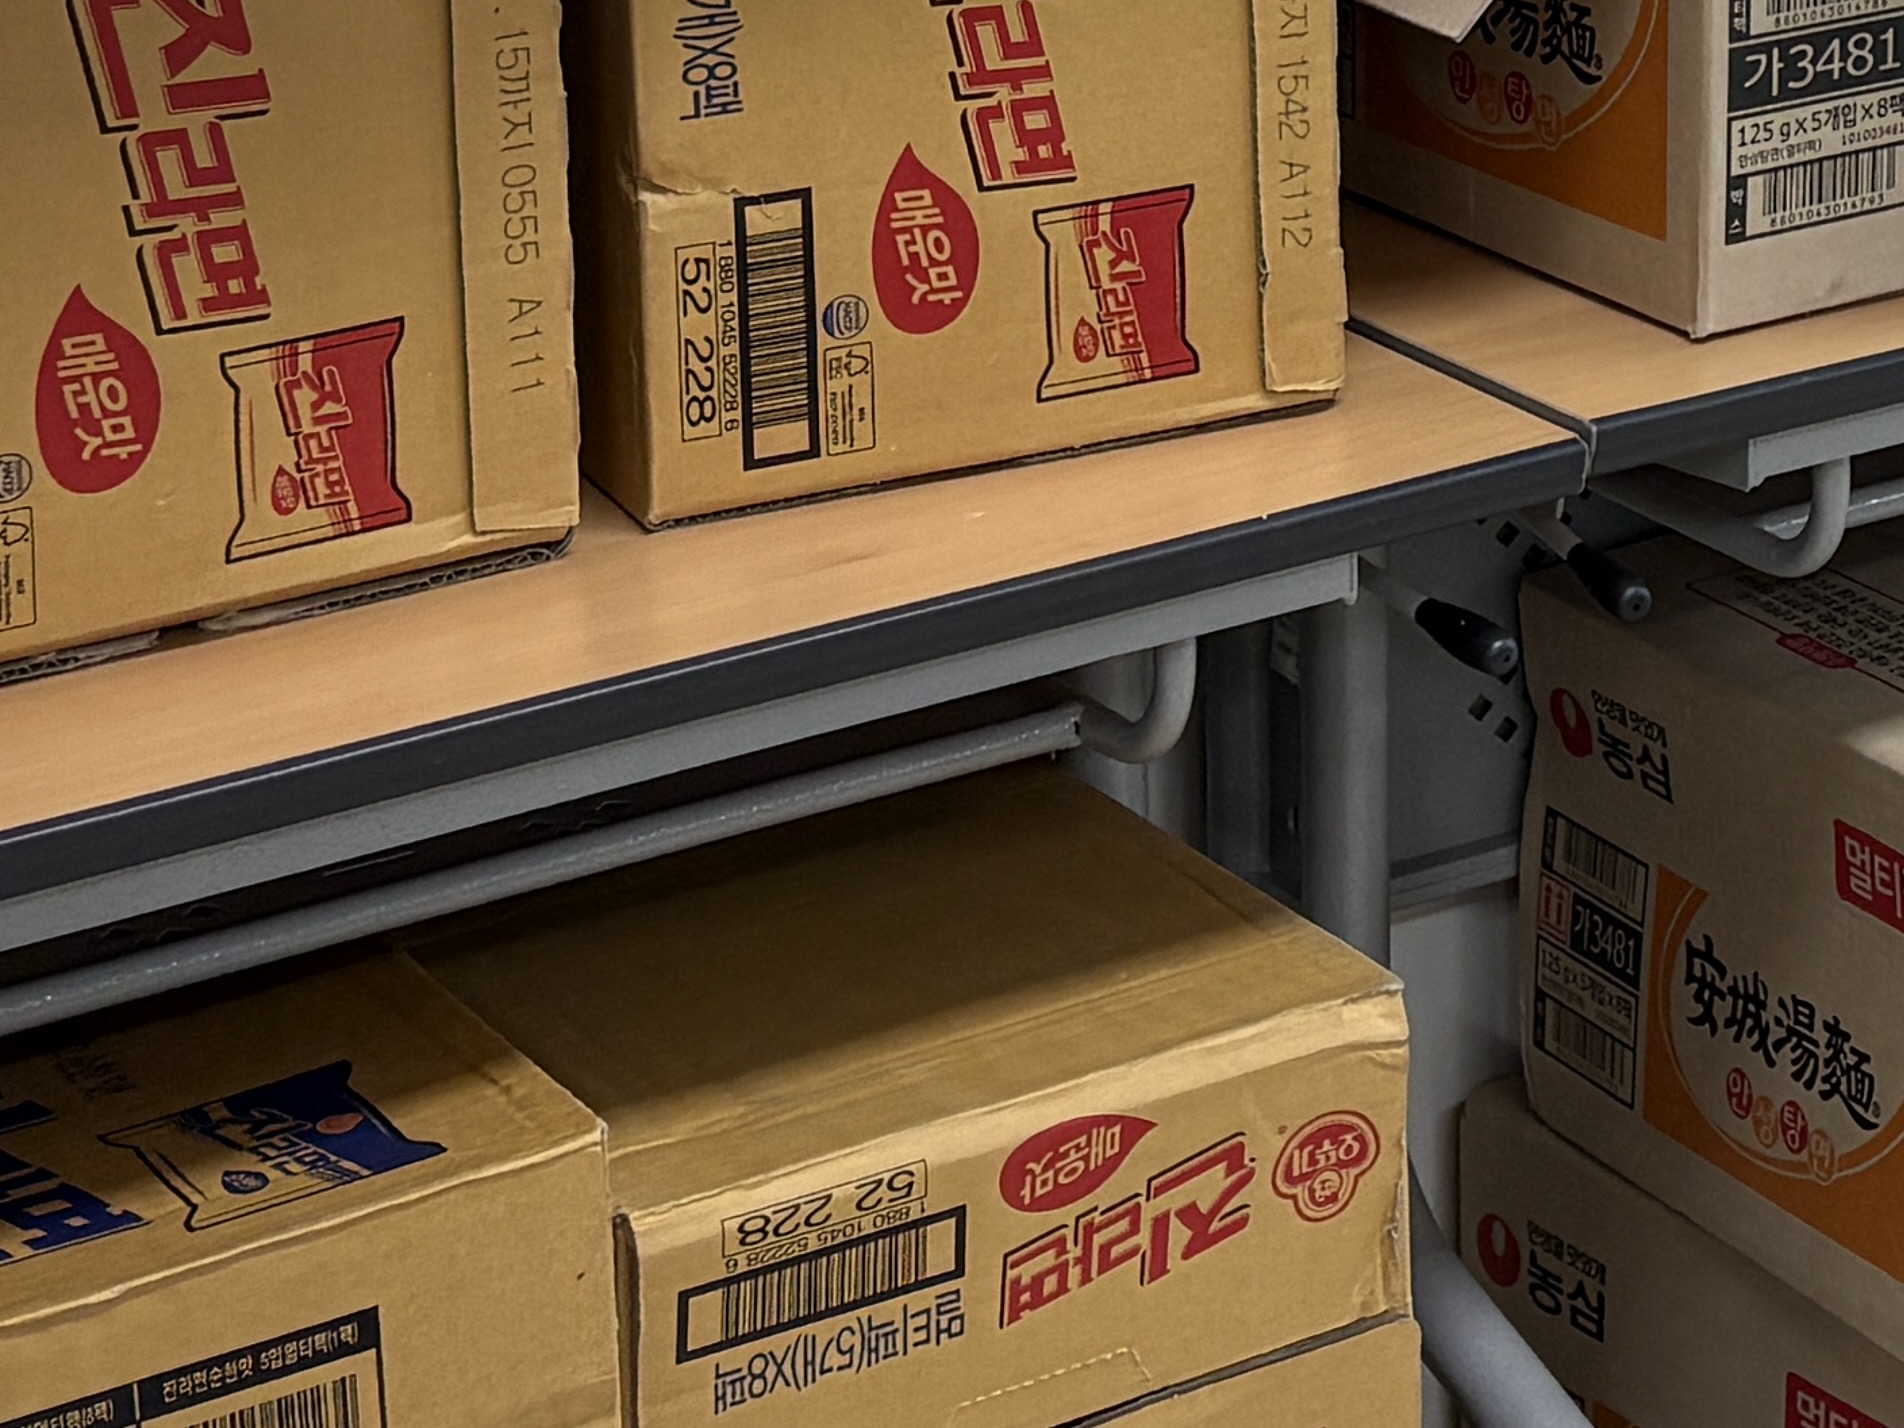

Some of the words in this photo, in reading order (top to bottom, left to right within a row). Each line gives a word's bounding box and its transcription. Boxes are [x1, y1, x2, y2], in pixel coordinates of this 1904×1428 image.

[1276, 49, 1310, 142] 1542
[1743, 26, 1902, 97] 가3481
[1277, 160, 1312, 249] A112
[679, 253, 711, 316] 52
[888, 191, 965, 310] 매운맛
[1085, 226, 1145, 358] 진라면
[507, 296, 547, 394] A111
[683, 338, 717, 428] 228
[55, 332, 143, 467] 매운맛
[281, 364, 352, 510] 진라면
[1596, 724, 1675, 805] 농심
[1574, 904, 1637, 976] 가3481
[1019, 1123, 1122, 1205] 매운맛
[1289, 1134, 1360, 1182] 오뚜기
[1726, 1066, 1838, 1183] 안성탕면
[737, 1193, 834, 1247] 228
[853, 1169, 916, 1212] 52
[1000, 1132, 1259, 1330] 진라면
[1525, 1255, 1606, 1345] 농심
